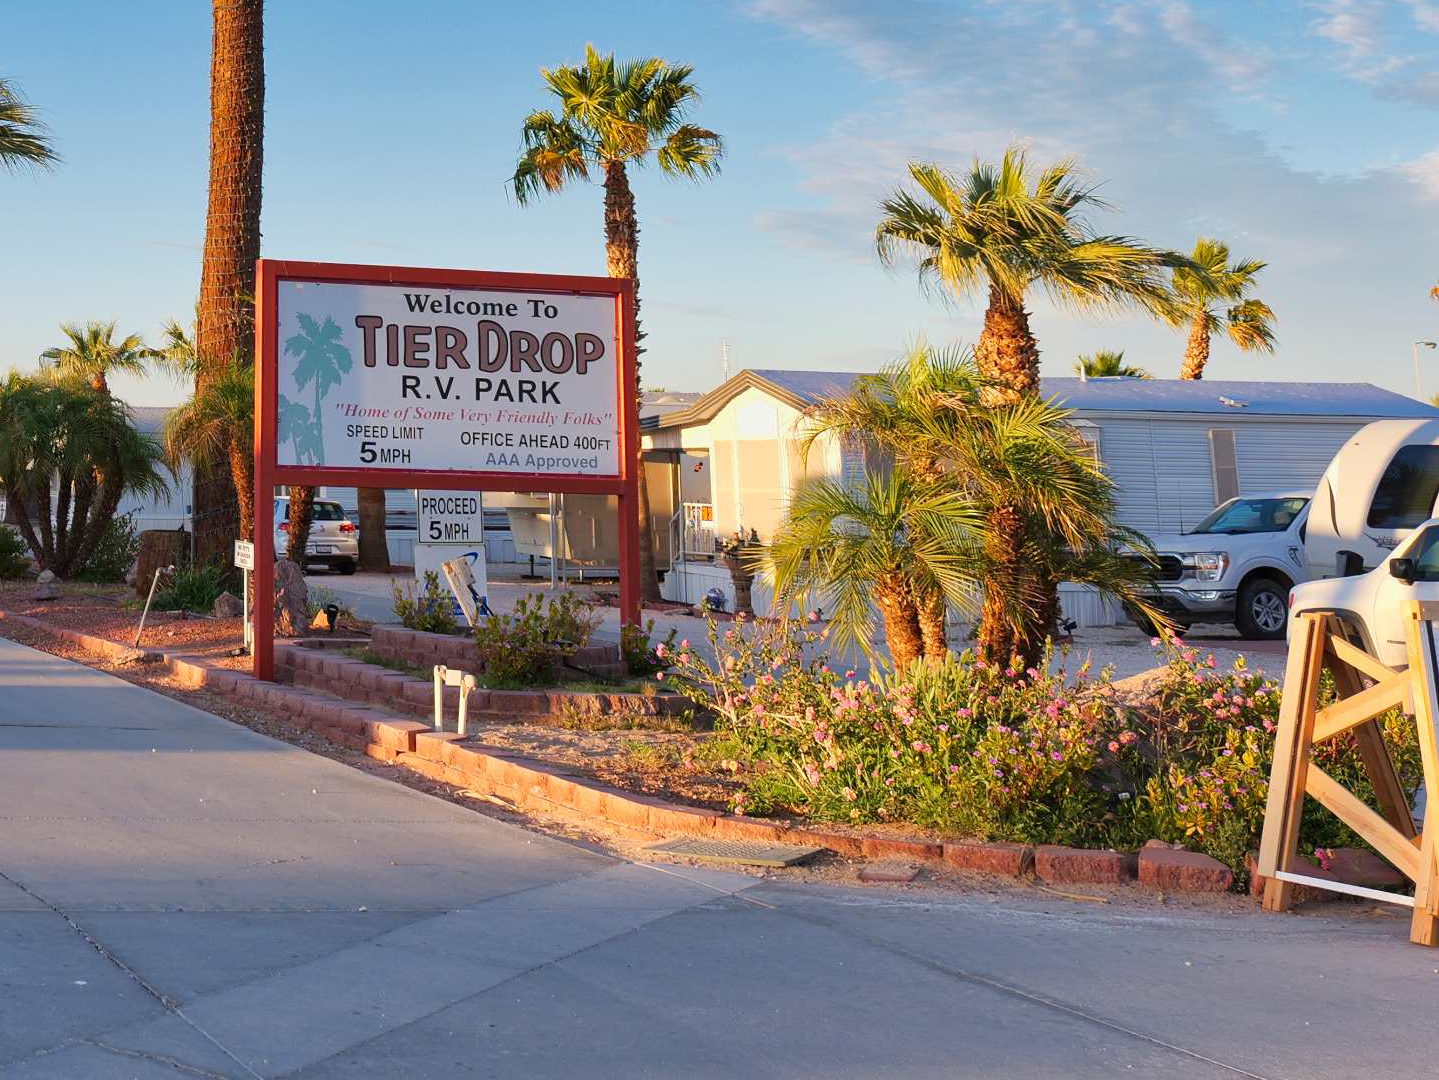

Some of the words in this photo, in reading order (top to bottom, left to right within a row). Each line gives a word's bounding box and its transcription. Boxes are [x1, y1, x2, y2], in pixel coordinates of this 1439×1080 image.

[403, 293, 518, 317] Welcome
[527, 299, 559, 319] To
[355, 315, 471, 370] TIER
[477, 320, 605, 375] DROP
[401, 375, 461, 400] R.V.
[475, 377, 562, 405] PARK
[336, 403, 390, 418] "Home
[394, 406, 412, 422] of
[413, 407, 455, 421] Some
[460, 409, 491, 426] Very
[497, 409, 558, 427] Friendly
[346, 424, 389, 439] SPEED
[392, 426, 424, 440] LIMIT
[460, 431, 514, 447] OFFICE
[518, 434, 569, 449] AHEAD
[359, 441, 377, 463] 5
[380, 448, 411, 463] MPH
[485, 452, 520, 466] AAA
[525, 454, 599, 469] Approved
[422, 497, 477, 515] PROCEED
[429, 520, 442, 540] 5
[444, 523, 469, 540] MPH
